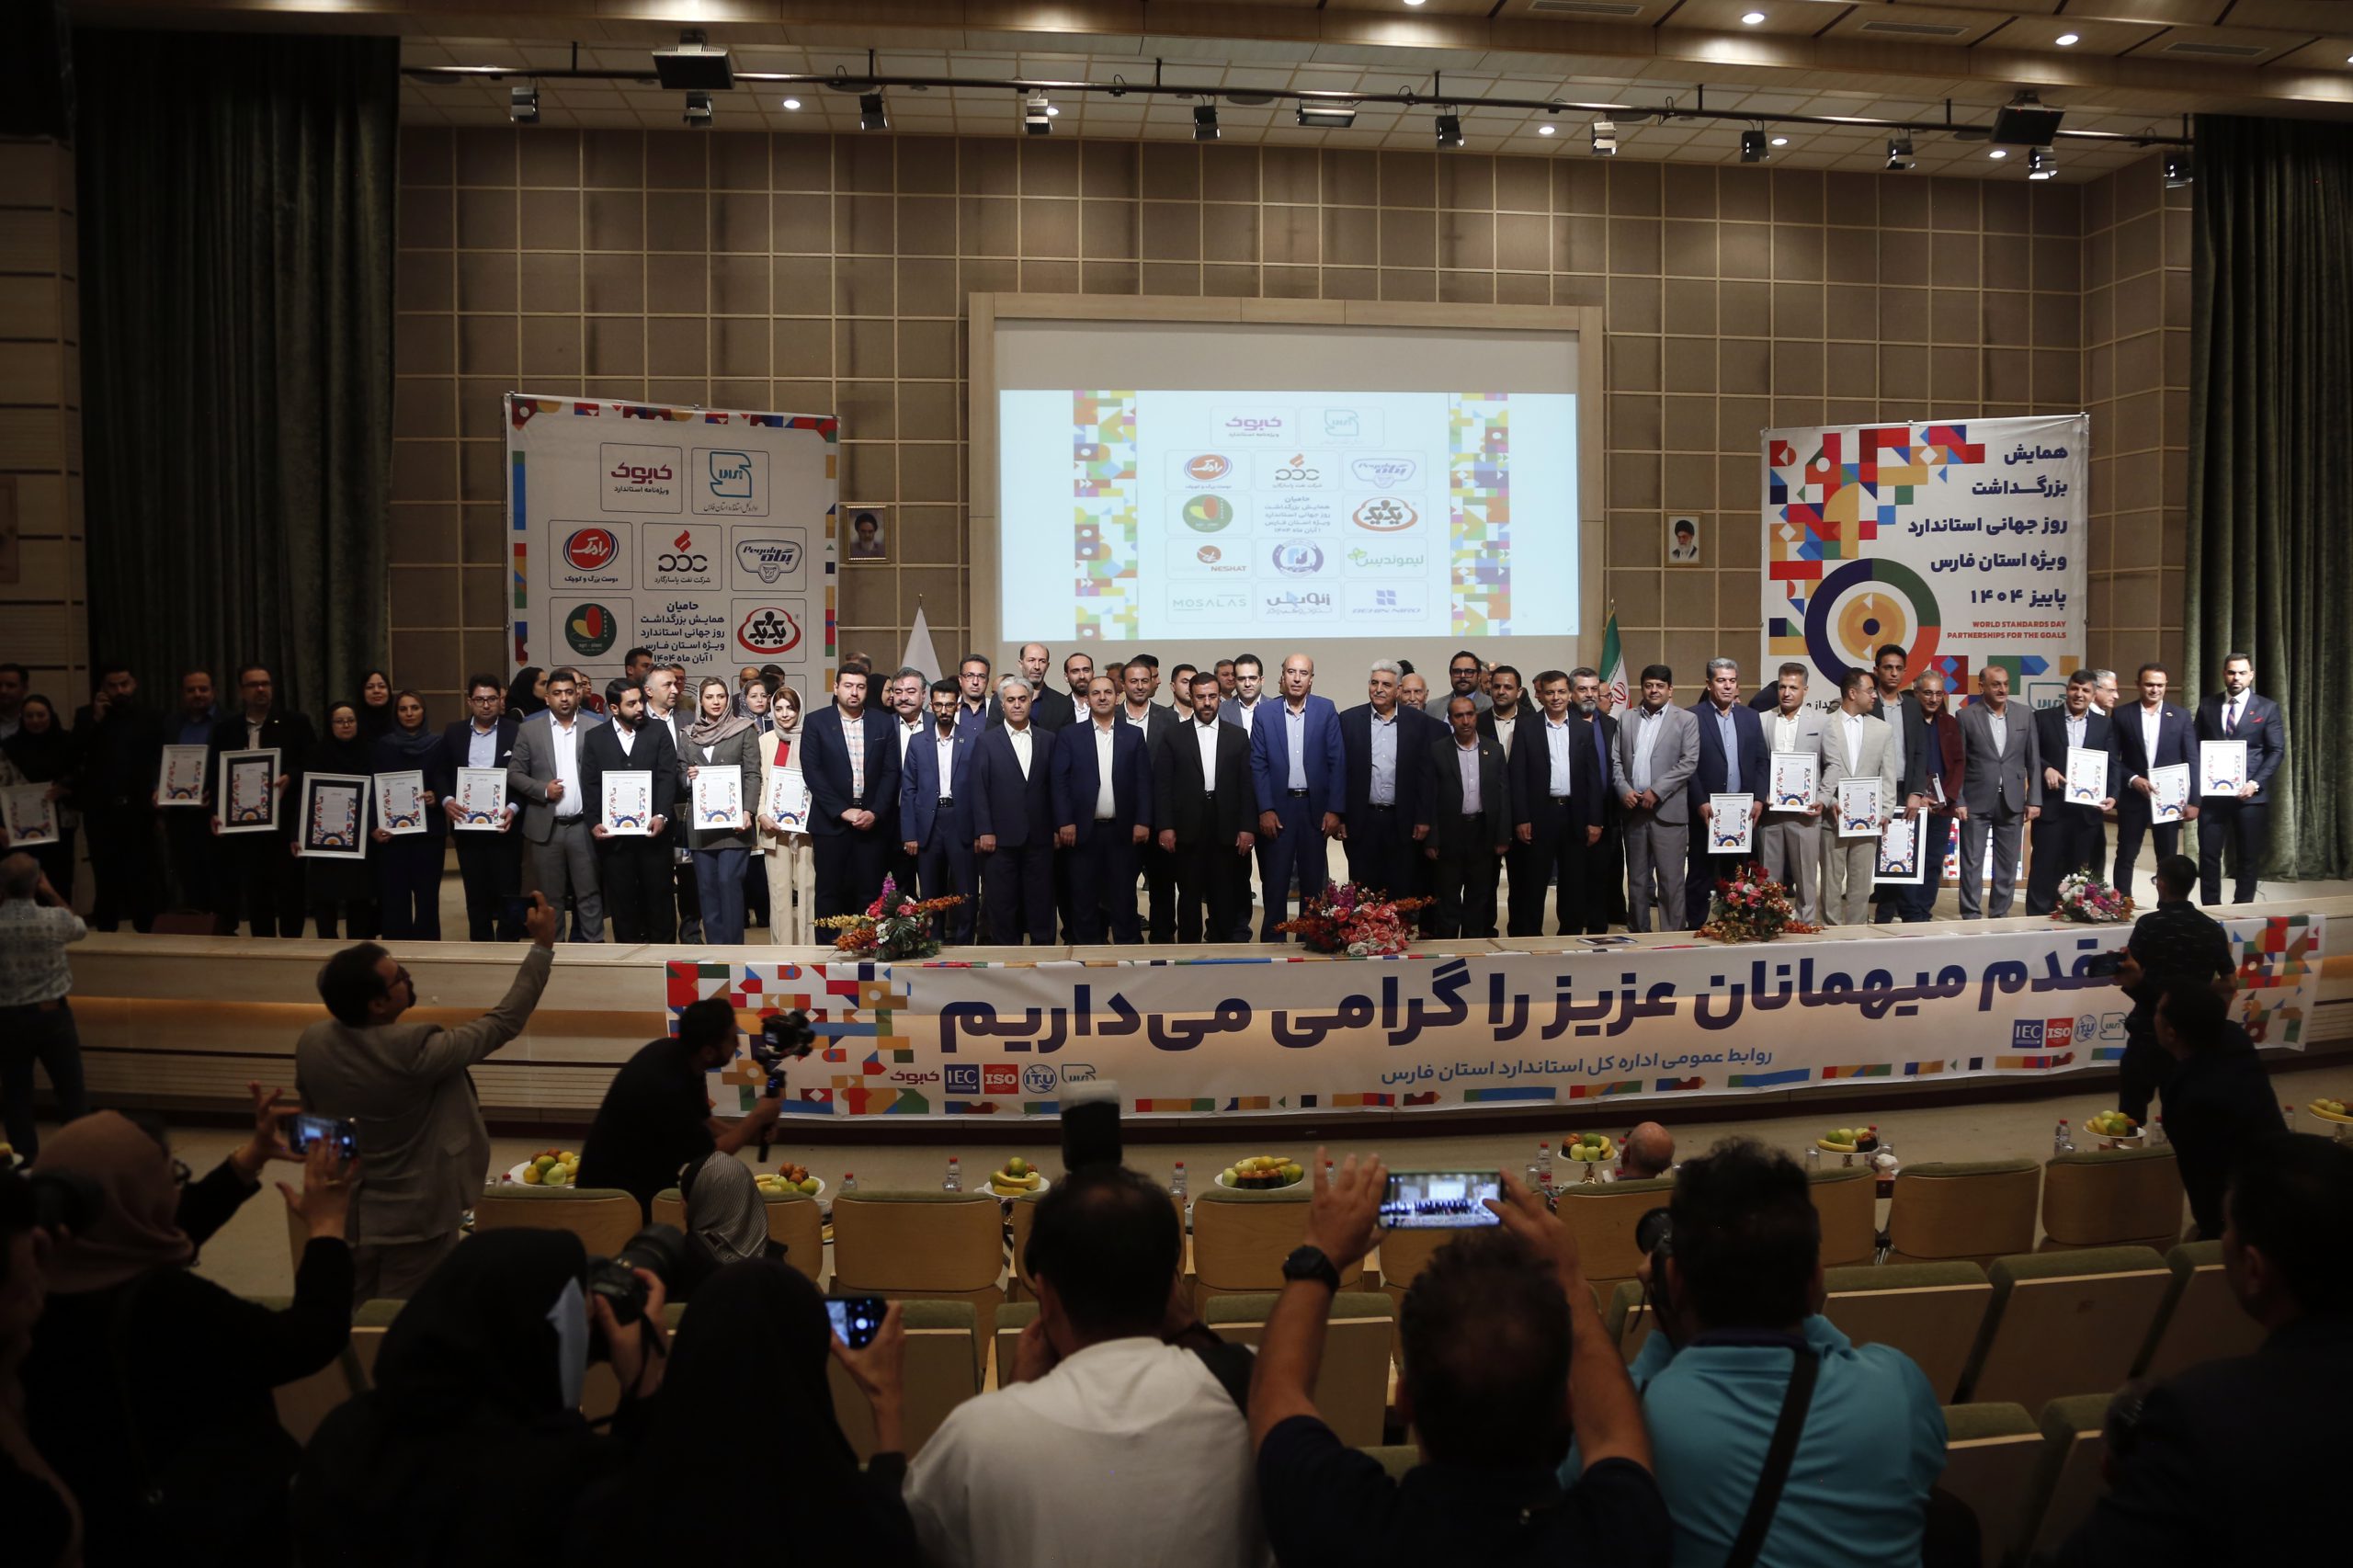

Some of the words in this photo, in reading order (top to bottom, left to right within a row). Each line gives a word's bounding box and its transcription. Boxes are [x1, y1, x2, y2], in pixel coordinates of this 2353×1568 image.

[2004, 444, 2068, 465] همایش
[1972, 475, 2068, 497] بزرگداشت
[1908, 517, 1982, 537] استاندارد
[1986, 517, 2038, 535] جهانی
[2041, 517, 2068, 534] روز
[1930, 552, 1975, 572] فارس
[1979, 552, 2027, 572] استان
[2030, 550, 2067, 571] ویژه
[1173, 598, 1246, 608] MOSALAS
[1971, 589, 2024, 603] ۱۴۰۴
[2029, 588, 2067, 610] پاییز
[666, 601, 699, 612] حامیان
[640, 614, 687, 625] بزرگداشت
[689, 615, 724, 624] همایش
[640, 628, 682, 639] استاندارد
[685, 629, 710, 638] جهانی
[711, 629, 724, 638] روز
[671, 642, 700, 651] استان
[702, 642, 725, 651] ویژه
[692, 652, 709, 664] آبان
[1694, 958, 1967, 1029] میهمانان
[1271, 957, 1471, 1049] گرامی
[1487, 972, 1529, 1041] را
[1541, 972, 1677, 1040] عزیز
[2016, 1025, 2042, 1039] IEC
[2047, 1027, 2072, 1039] ISO
[1587, 1055, 1615, 1075] کل
[1619, 1053, 1658, 1072] اداره
[1662, 1052, 1722, 1069] عمومی
[1727, 1048, 1772, 1065] روابط
[948, 1069, 977, 1084] IEC
[1381, 1064, 1434, 1085] فارس
[1438, 1061, 1494, 1082] استان
[1498, 1058, 1583, 1078] استاندارد
[984, 1074, 1017, 1085] ISO
[1025, 1073, 1054, 1085] ITU
